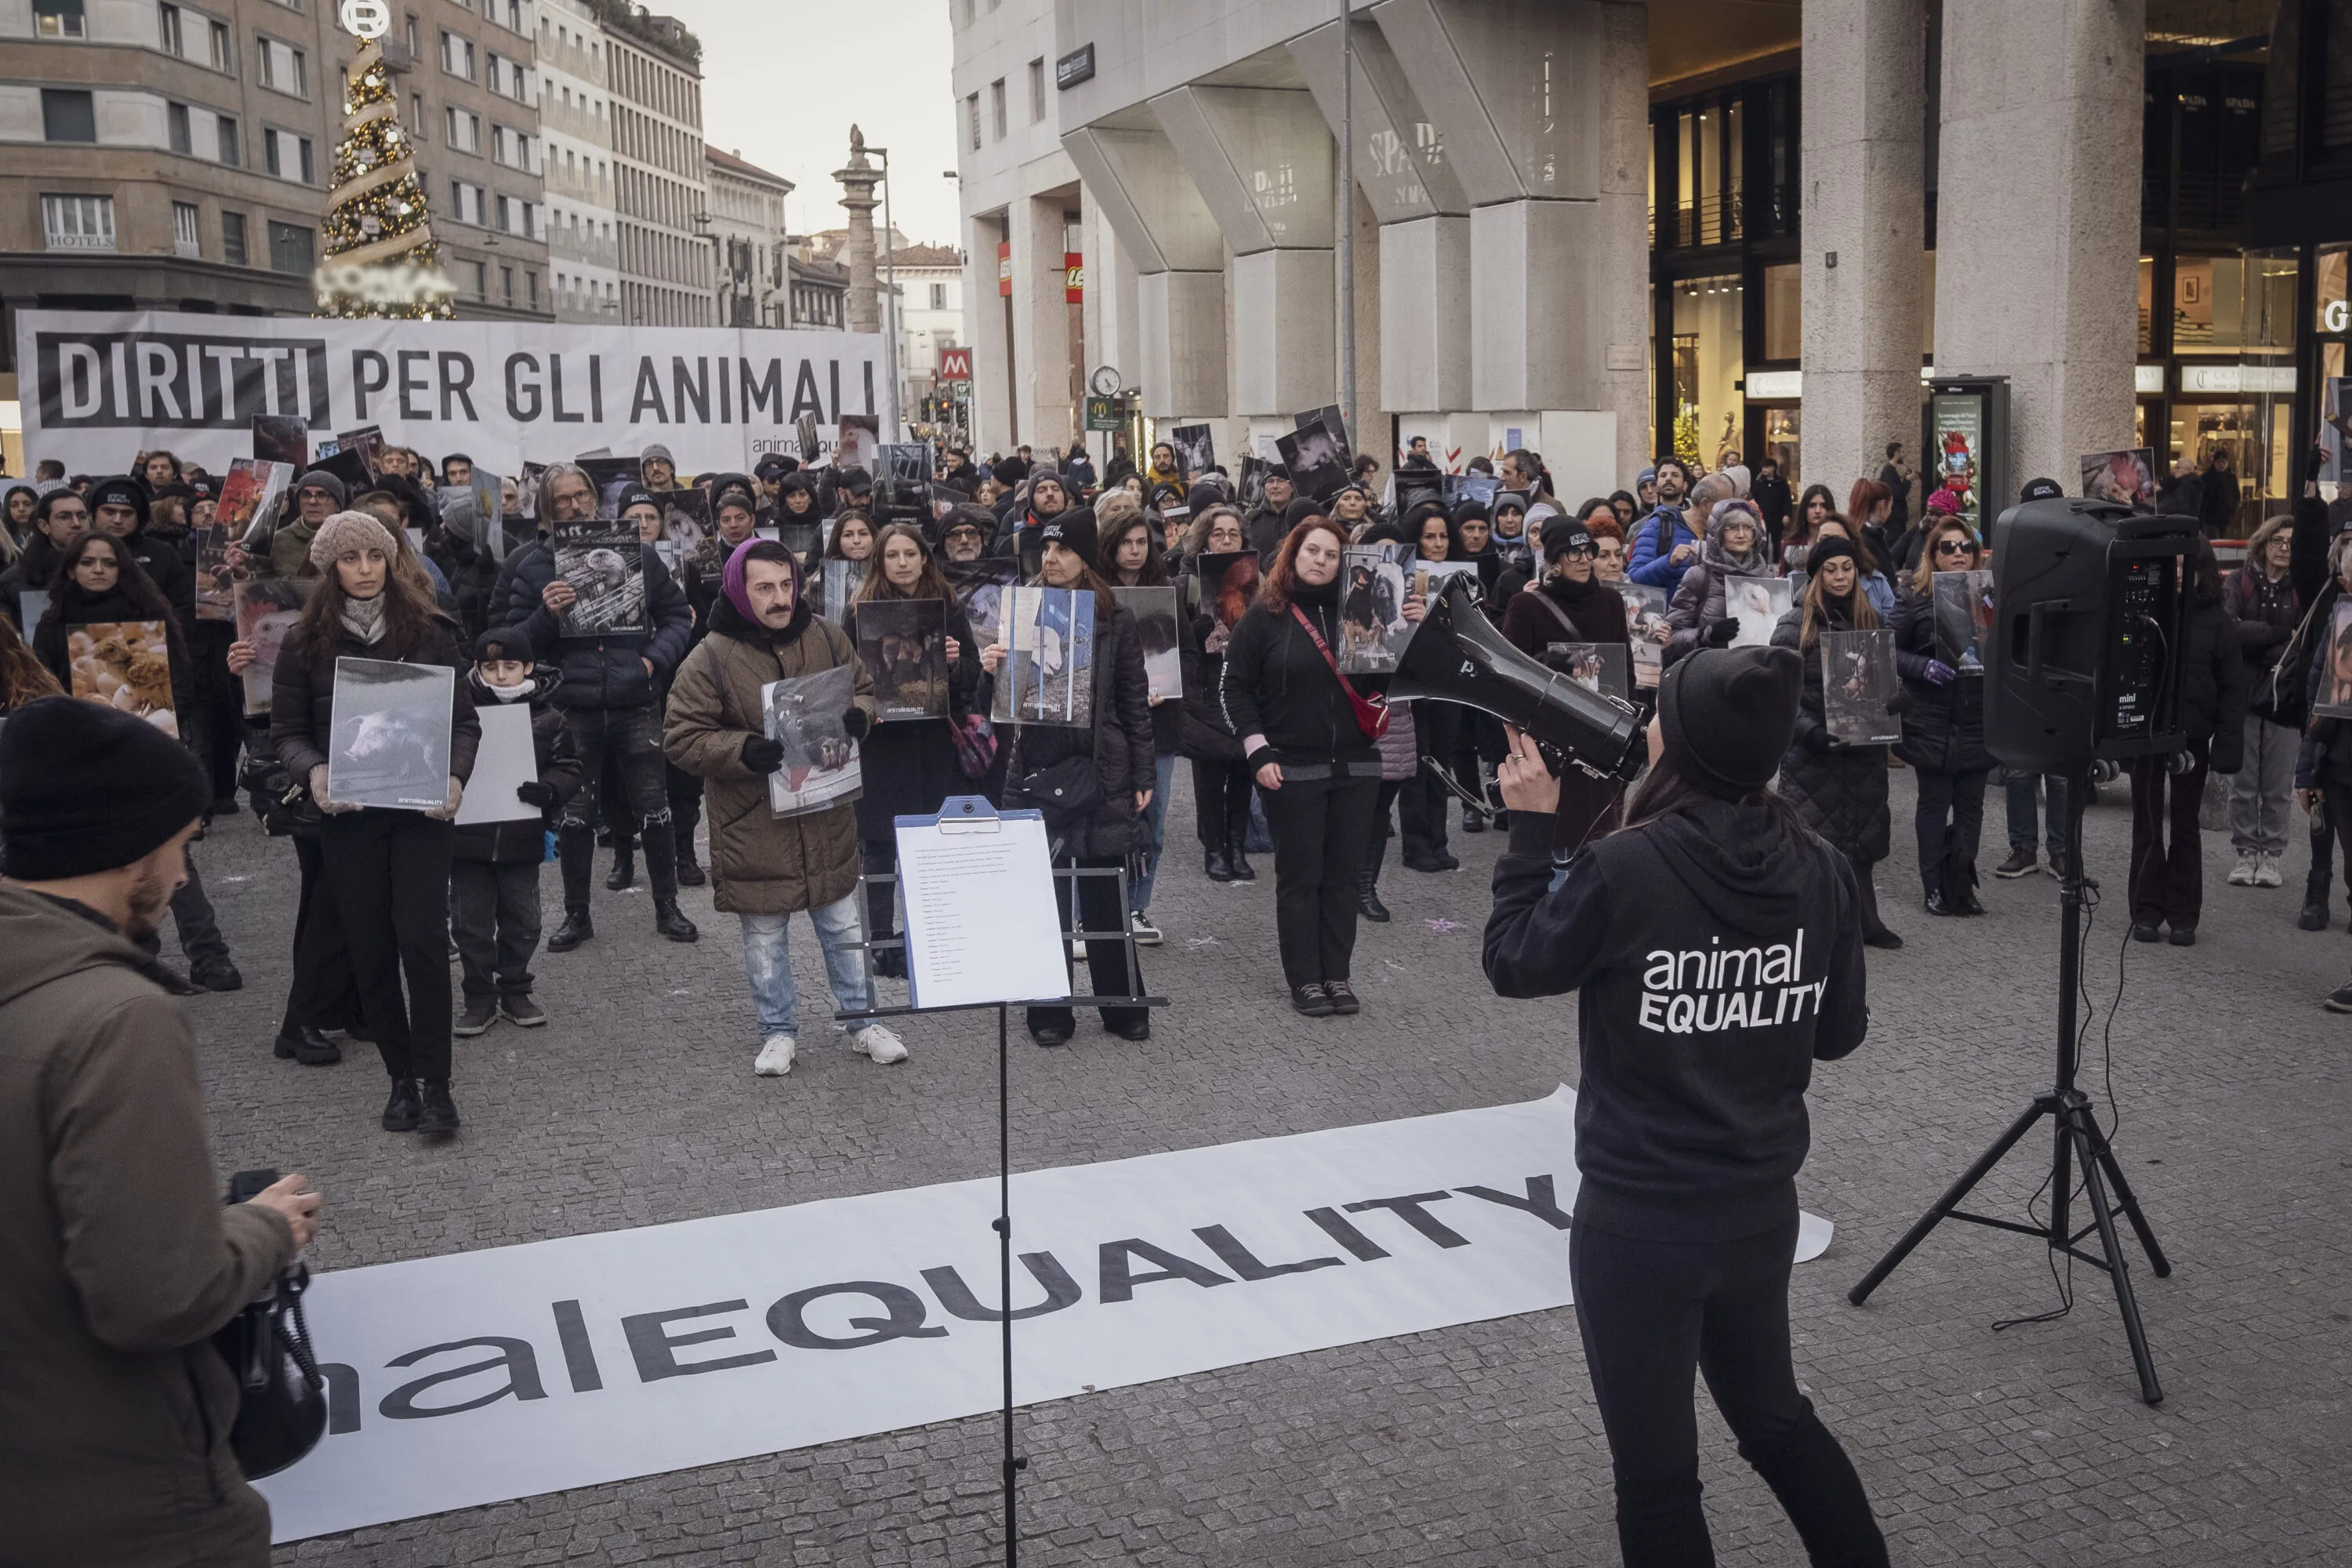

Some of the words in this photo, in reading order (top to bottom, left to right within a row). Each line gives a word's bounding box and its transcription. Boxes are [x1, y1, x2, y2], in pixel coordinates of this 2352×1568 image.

[50, 235, 114, 248] HOTELS
[58, 341, 312, 421] DIRITTI
[352, 349, 479, 422] PER
[504, 351, 605, 423] GLI
[629, 354, 876, 426] ANIMALI
[2119, 693, 2136, 703] mini
[1643, 927, 1804, 991] animal
[1638, 975, 1828, 1034] EQUALITY
